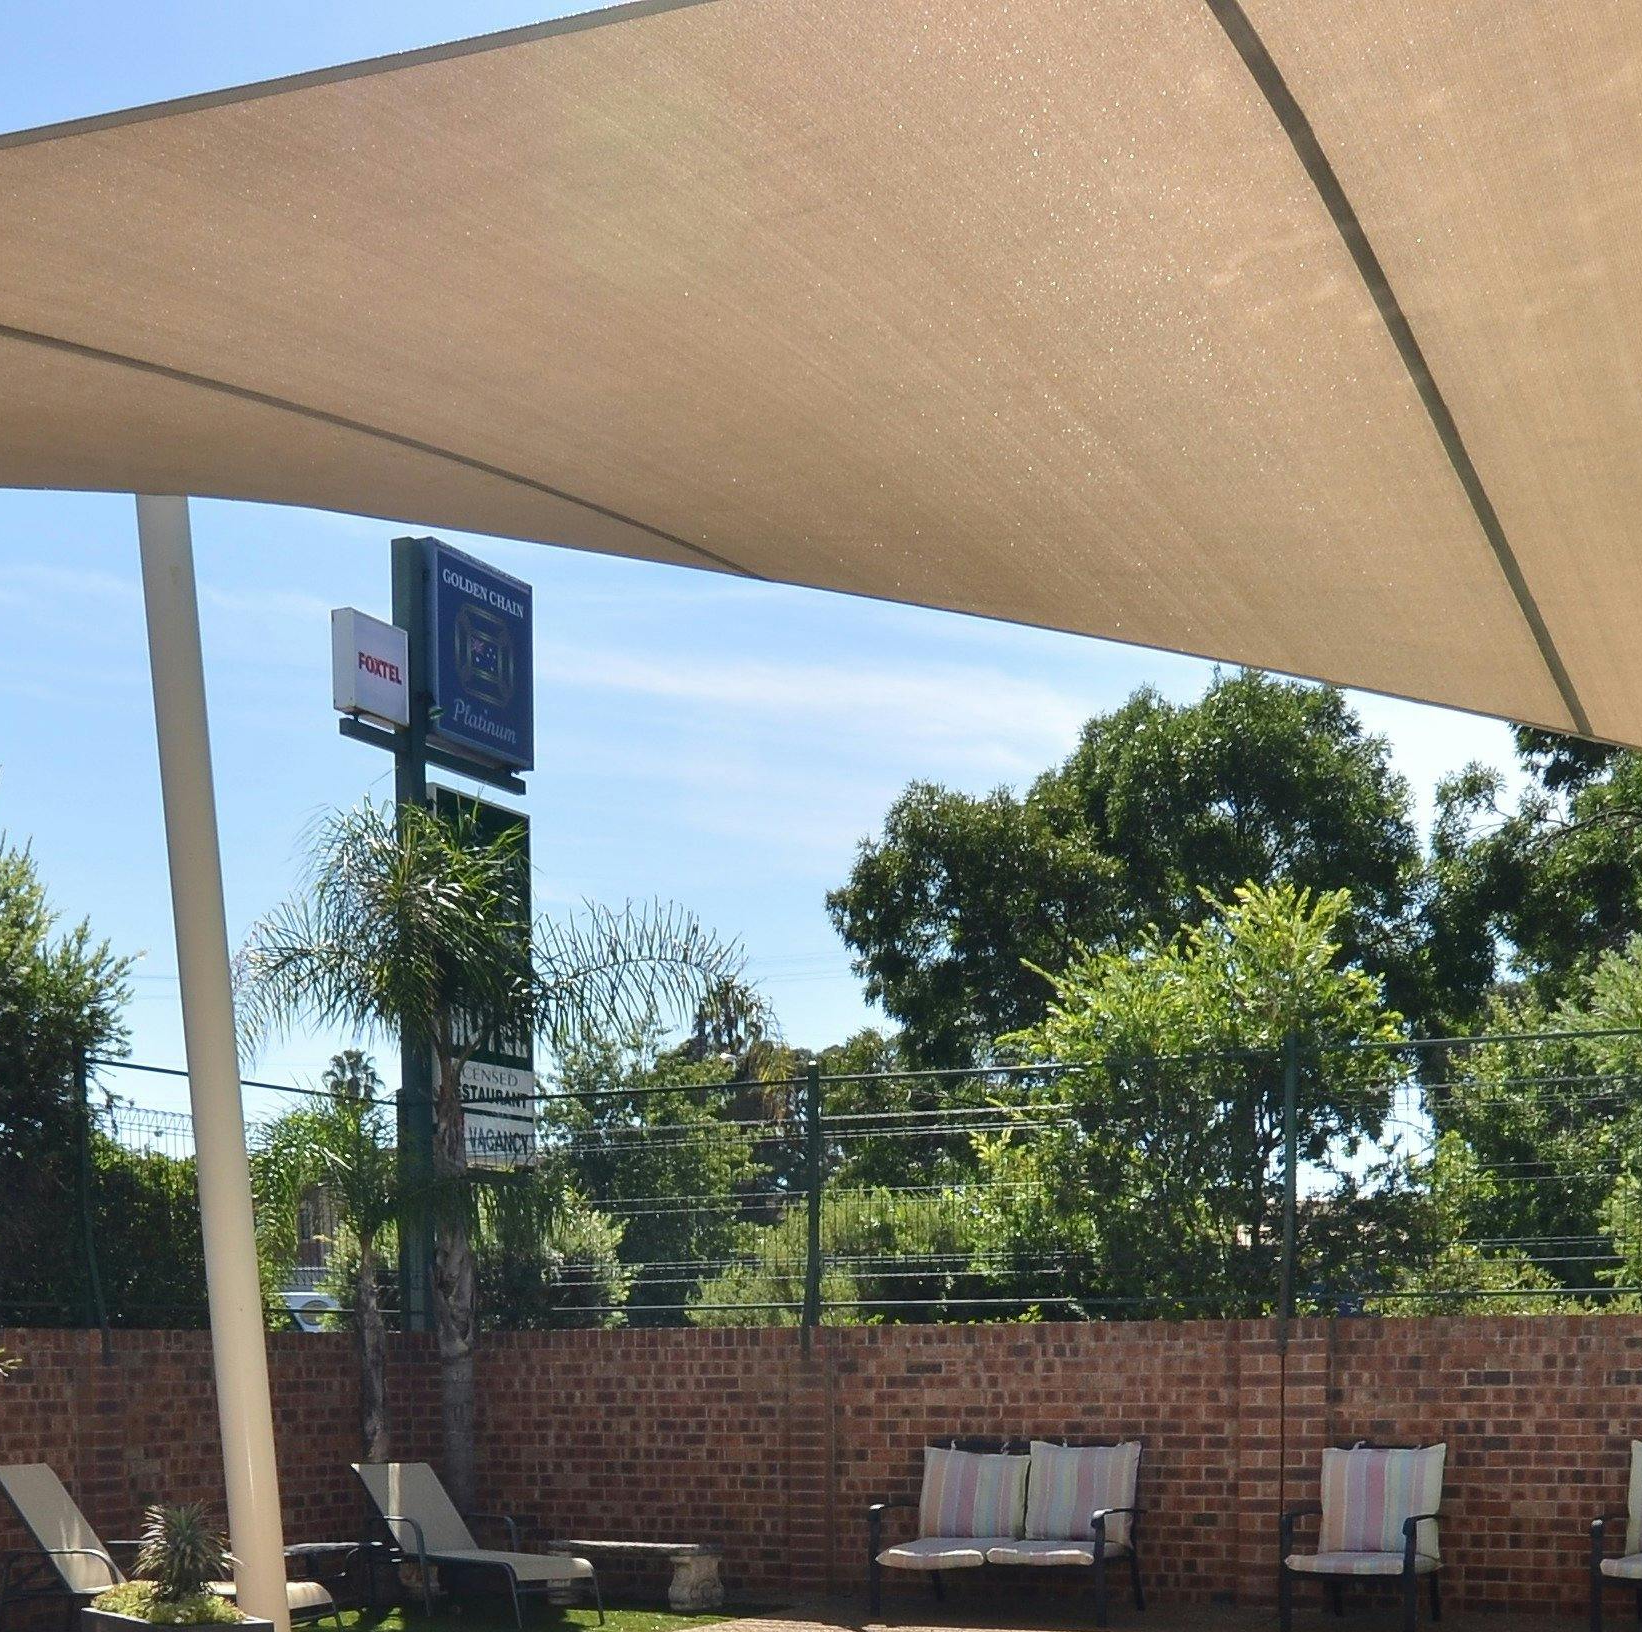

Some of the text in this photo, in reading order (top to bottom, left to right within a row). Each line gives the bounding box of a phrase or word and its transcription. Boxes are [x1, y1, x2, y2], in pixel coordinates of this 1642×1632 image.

[442, 568, 524, 619] GOLDEN CHAIN
[358, 651, 402, 686] FOXTEL
[453, 698, 517, 745] Platinum
[462, 1065, 519, 1088] CENSED
[460, 1083, 528, 1109] STAURANT
